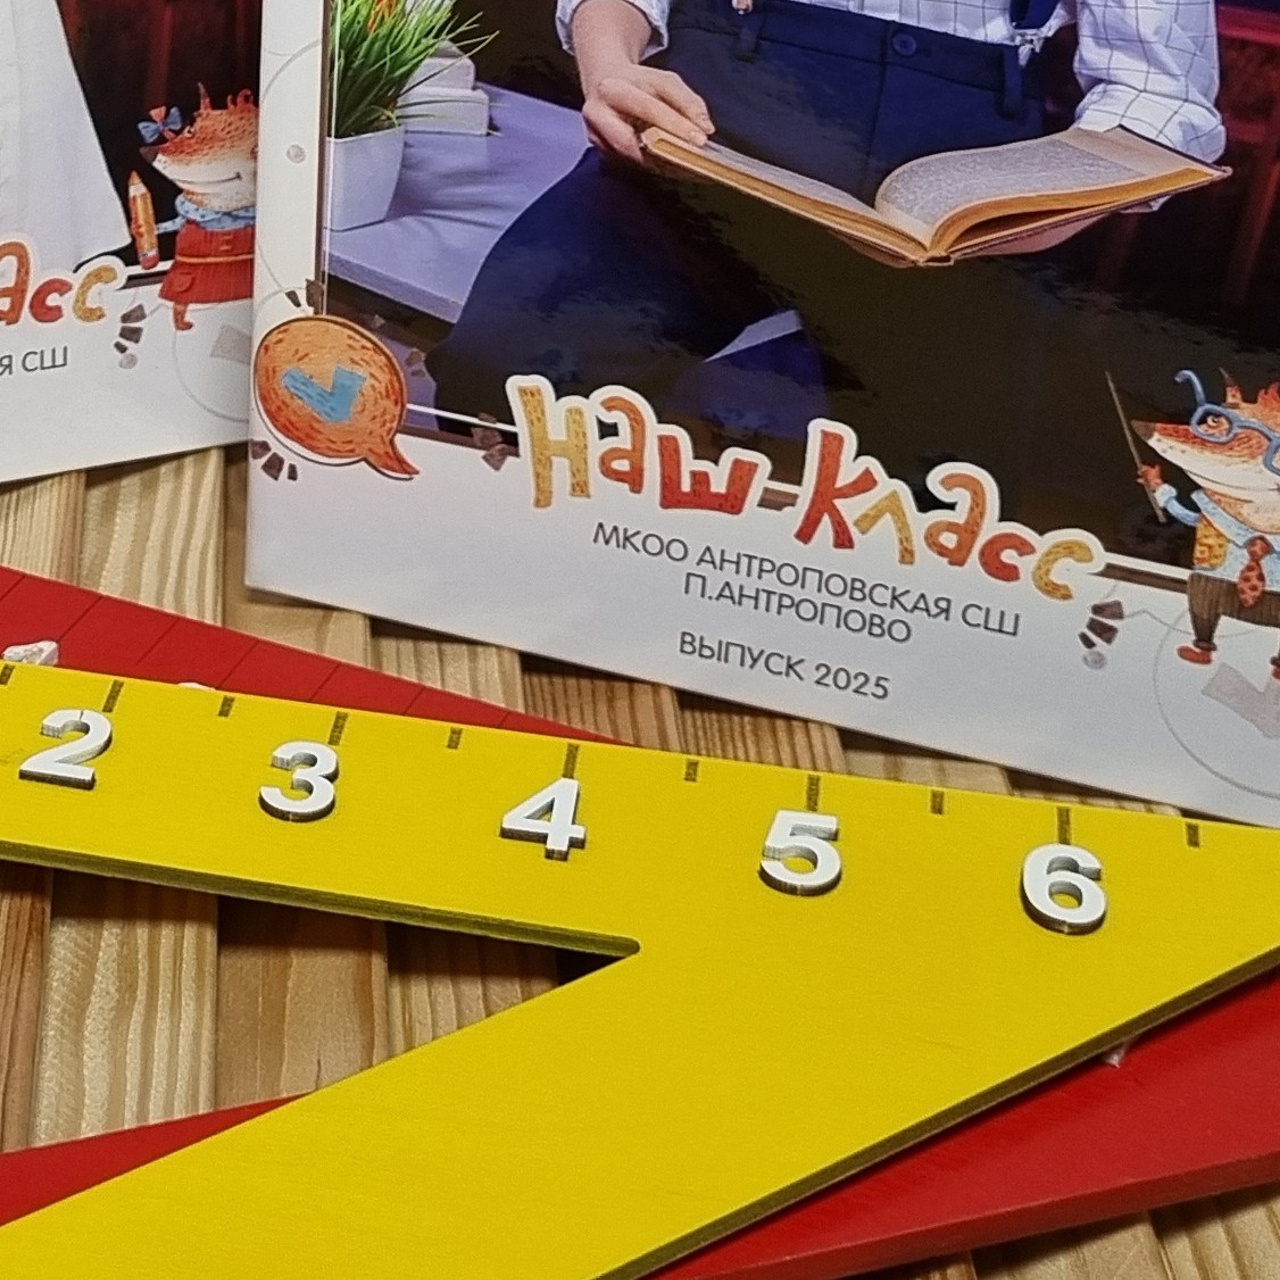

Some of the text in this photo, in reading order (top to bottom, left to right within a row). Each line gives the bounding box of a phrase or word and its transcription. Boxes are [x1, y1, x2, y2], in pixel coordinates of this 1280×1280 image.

[22, 346, 69, 372] СШ
[593, 522, 1021, 637] МКОО АНТРОПОВСКАЯ СШ
[684, 572, 912, 644] П.АНТРОПОВО
[679, 630, 890, 700] ВЫПУСК 2025
[19, 708, 113, 790] 2
[259, 740, 340, 822] 3
[499, 776, 587, 861] 4
[758, 808, 842, 896] 5
[1020, 841, 1108, 935] 6
